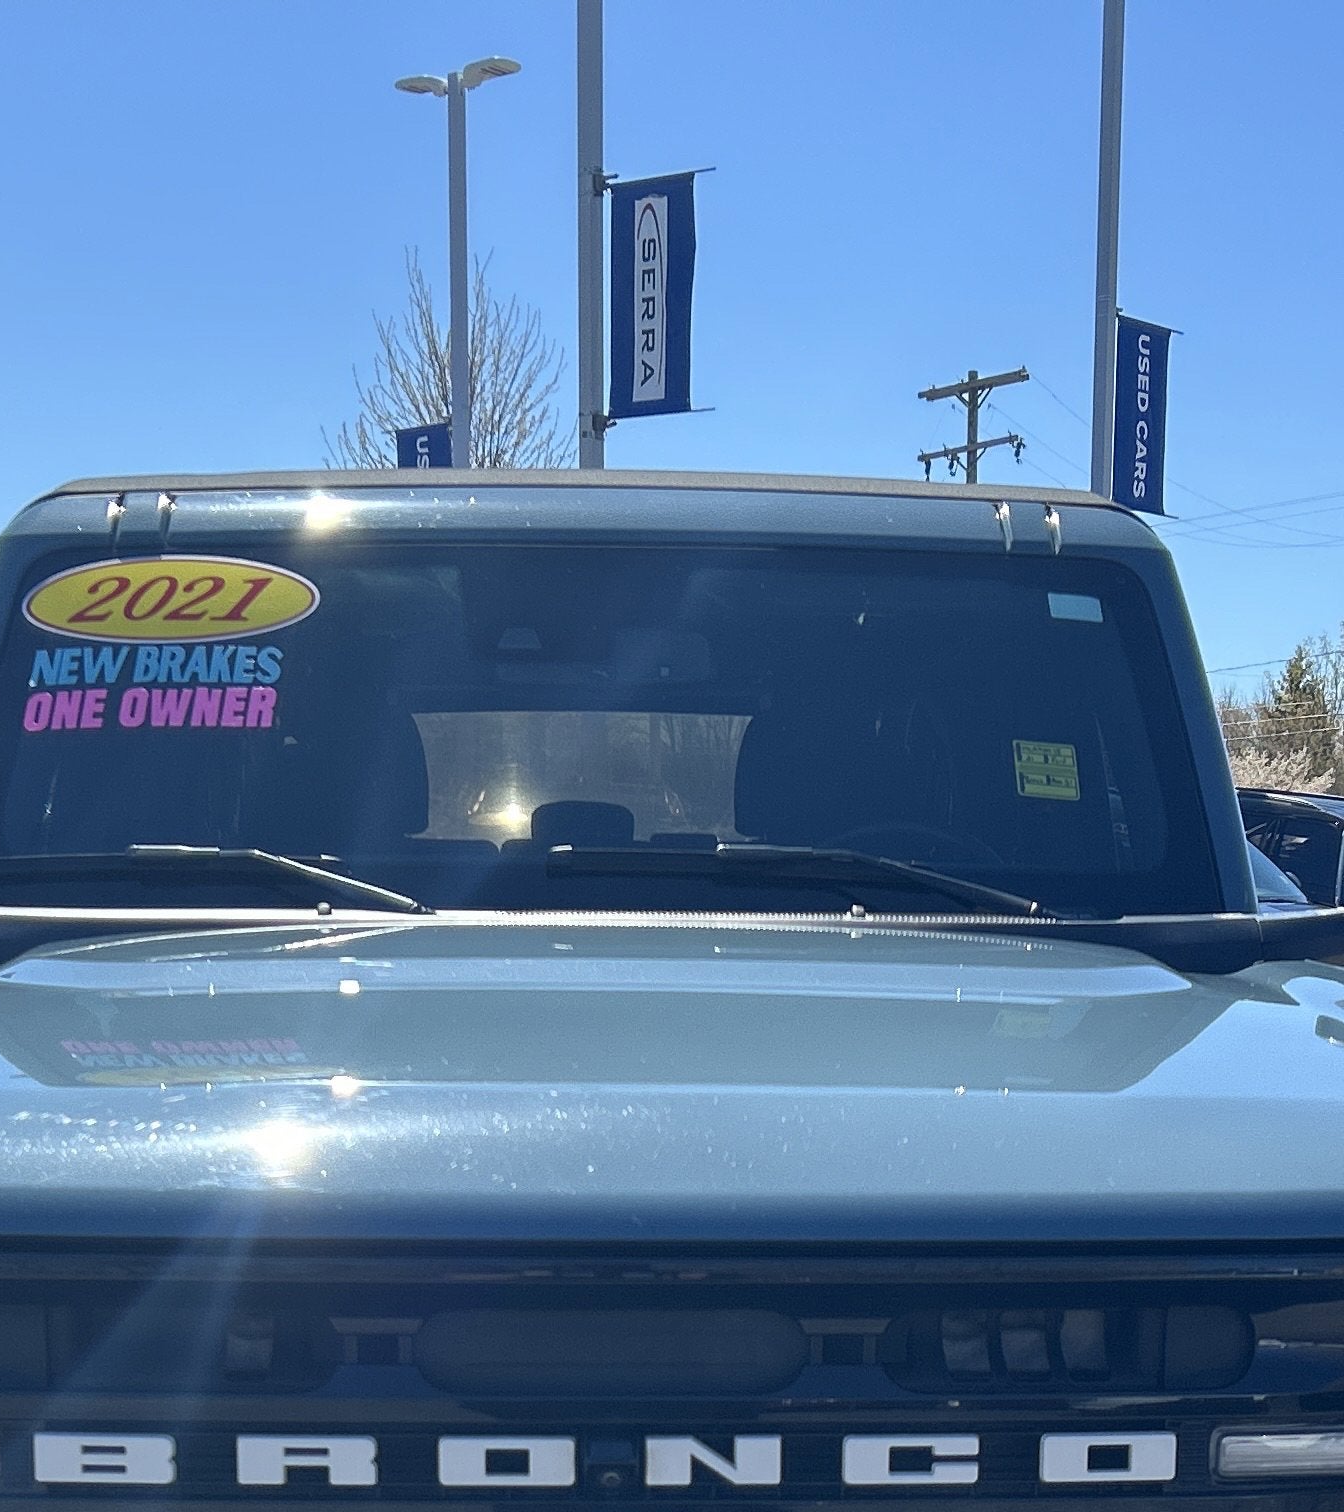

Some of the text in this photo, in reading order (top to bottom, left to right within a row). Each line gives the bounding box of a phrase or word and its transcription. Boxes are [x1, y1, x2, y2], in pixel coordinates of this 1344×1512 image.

[640, 237, 657, 388] SERRA
[1132, 334, 1151, 499] USED CARS
[67, 576, 274, 623] 2021
[28, 645, 284, 687] NEW BRAKES
[23, 686, 278, 732] ONE OWNER
[32, 1431, 1178, 1487] BRONCO
